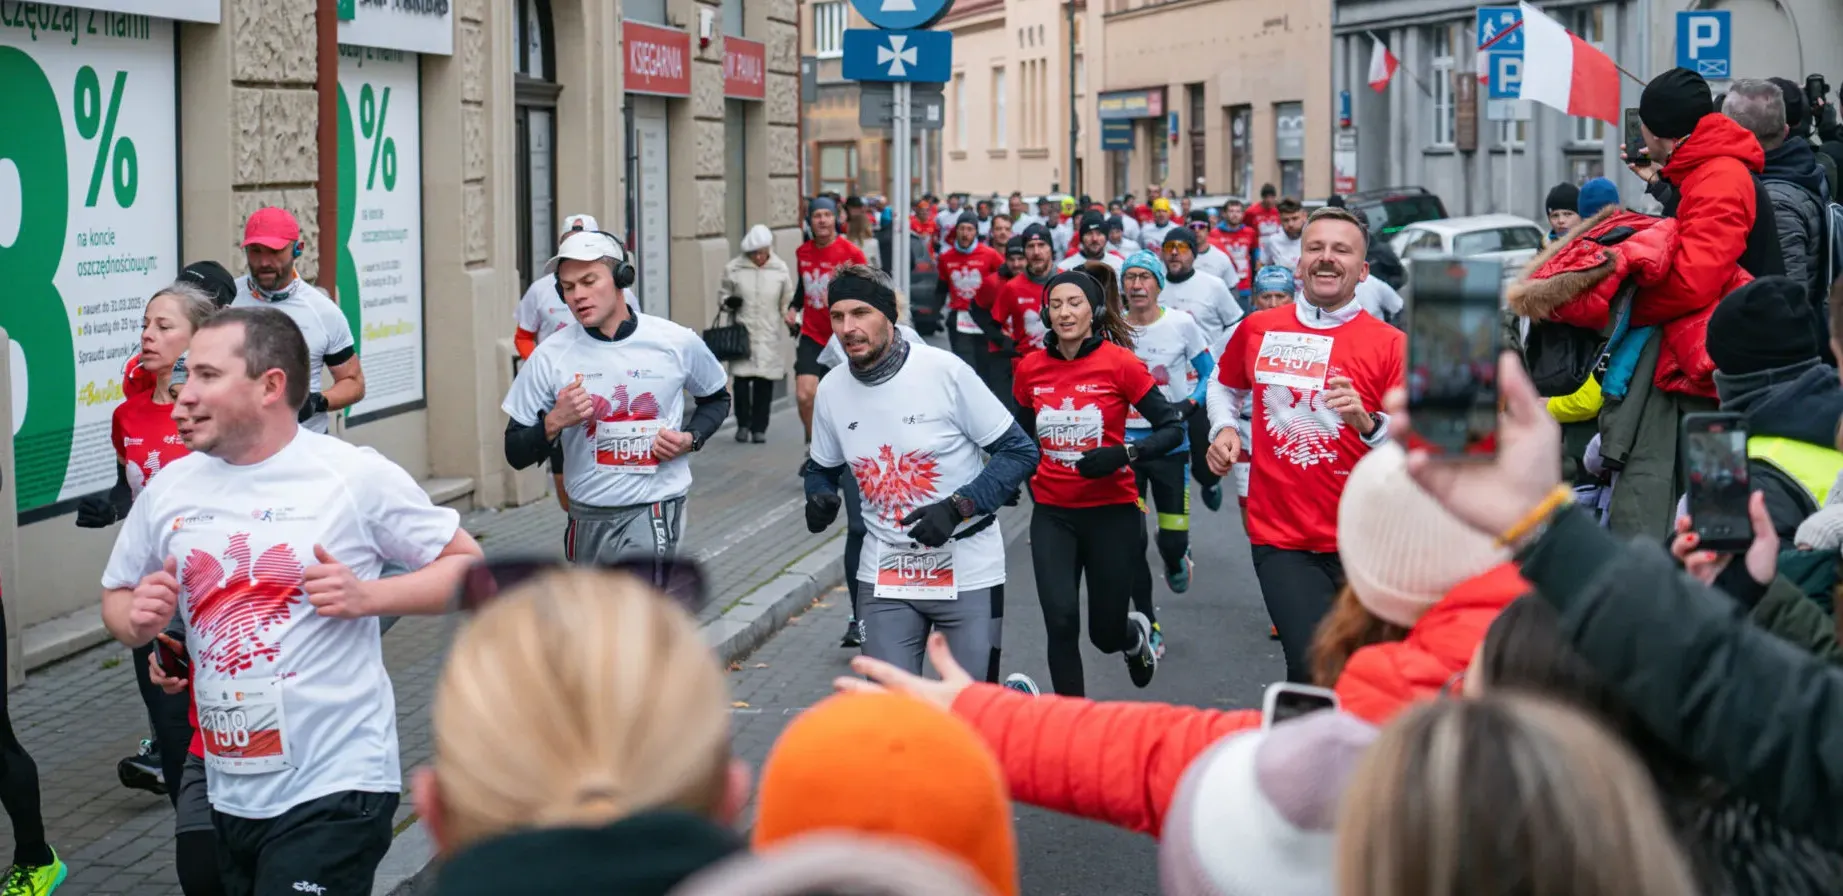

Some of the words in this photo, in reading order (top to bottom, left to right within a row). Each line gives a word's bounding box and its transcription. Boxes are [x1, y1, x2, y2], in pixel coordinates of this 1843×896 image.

[1689, 16, 1720, 60] P
[630, 40, 683, 84] KSIĘGARNIA
[1498, 57, 1524, 92] P
[77, 231, 87, 247] na
[89, 227, 115, 247] koncie
[1269, 345, 1317, 370] 2437
[611, 438, 651, 460] 1941
[1047, 426, 1087, 447] 1642
[894, 555, 938, 579] 1512
[208, 710, 250, 747] 198
